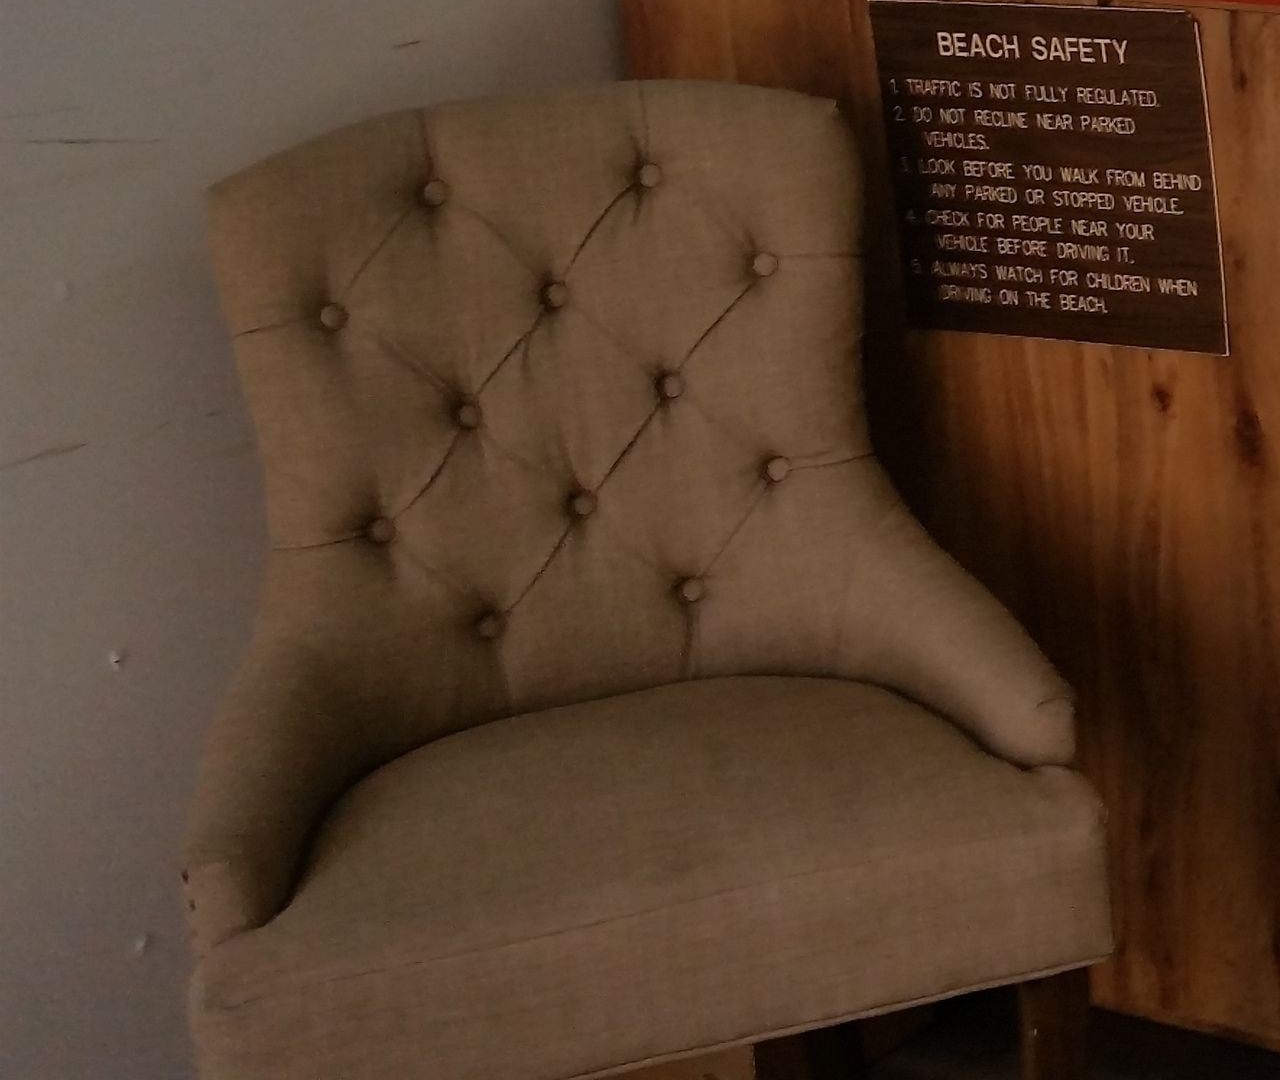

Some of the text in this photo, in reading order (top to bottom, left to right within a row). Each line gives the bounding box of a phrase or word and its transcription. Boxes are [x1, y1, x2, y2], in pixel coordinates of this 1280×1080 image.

[937, 31, 1128, 64] BEACH SAFETY
[906, 78, 962, 97] TRAFFIC
[968, 82, 983, 98] IS
[989, 82, 1016, 99] NOT
[1025, 85, 1068, 103] FULLY
[1076, 87, 1161, 107] REGULATED.
[913, 108, 932, 122] DO
[940, 108, 965, 124] NOT
[974, 110, 1028, 129] RECLINE
[1037, 114, 1073, 131] NEAR
[1081, 116, 1136, 134] PARKED
[924, 131, 990, 150] VEHICLES.
[919, 160, 955, 175] LOOK
[963, 160, 1015, 180] BEFORE
[1022, 164, 1052, 181] YOU
[1061, 167, 1099, 184] WALK
[1106, 169, 1146, 188] FROM
[1153, 172, 1201, 191] BEHIND
[931, 184, 956, 200] ANY
[966, 185, 1017, 204] PARKED
[1025, 189, 1045, 205] OR
[1053, 190, 1115, 210] STOPPED
[926, 210, 970, 226] CHECK
[978, 212, 1005, 229] FOR
[1012, 215, 1064, 235] PEOPLE
[1071, 218, 1108, 237] NEAR
[1115, 221, 1155, 241] YOUR
[937, 235, 989, 253] VEHICLE
[997, 237, 1048, 257] BEFORE
[1057, 241, 1109, 261] DRIVING
[933, 260, 988, 280] ALWAYS
[996, 264, 1043, 284] WATCH
[1050, 269, 1079, 288] FOR
[1086, 272, 1150, 292] CHILDREN
[1158, 278, 1198, 296] WHEN
[1000, 288, 1019, 305] ON
[1026, 290, 1051, 310] THE
